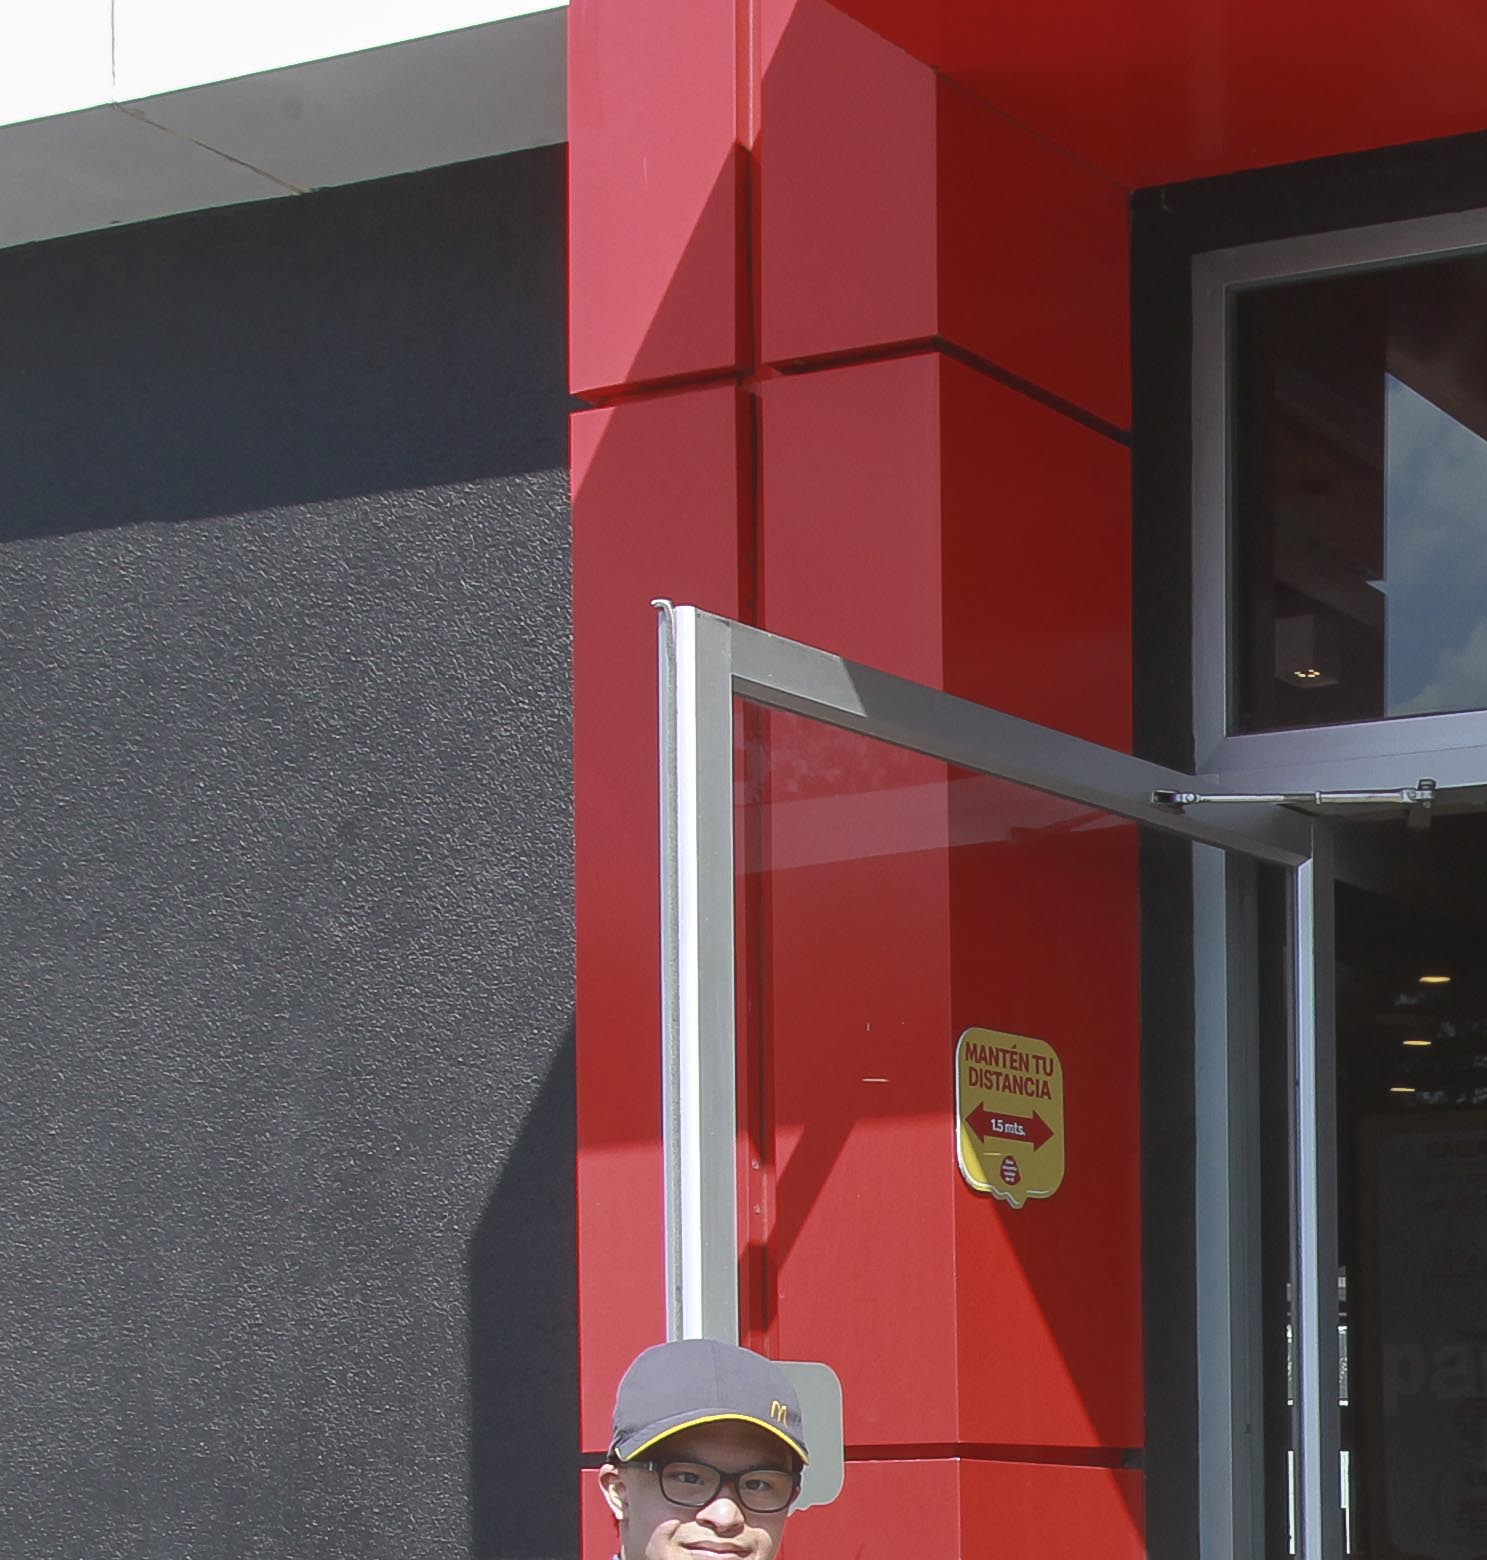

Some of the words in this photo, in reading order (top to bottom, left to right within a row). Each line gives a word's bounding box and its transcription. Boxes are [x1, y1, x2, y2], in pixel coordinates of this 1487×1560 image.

[965, 1041, 1030, 1073] MANTÉN
[1032, 1054, 1054, 1077] TU
[968, 1066, 1052, 1100] DISTANCIA
